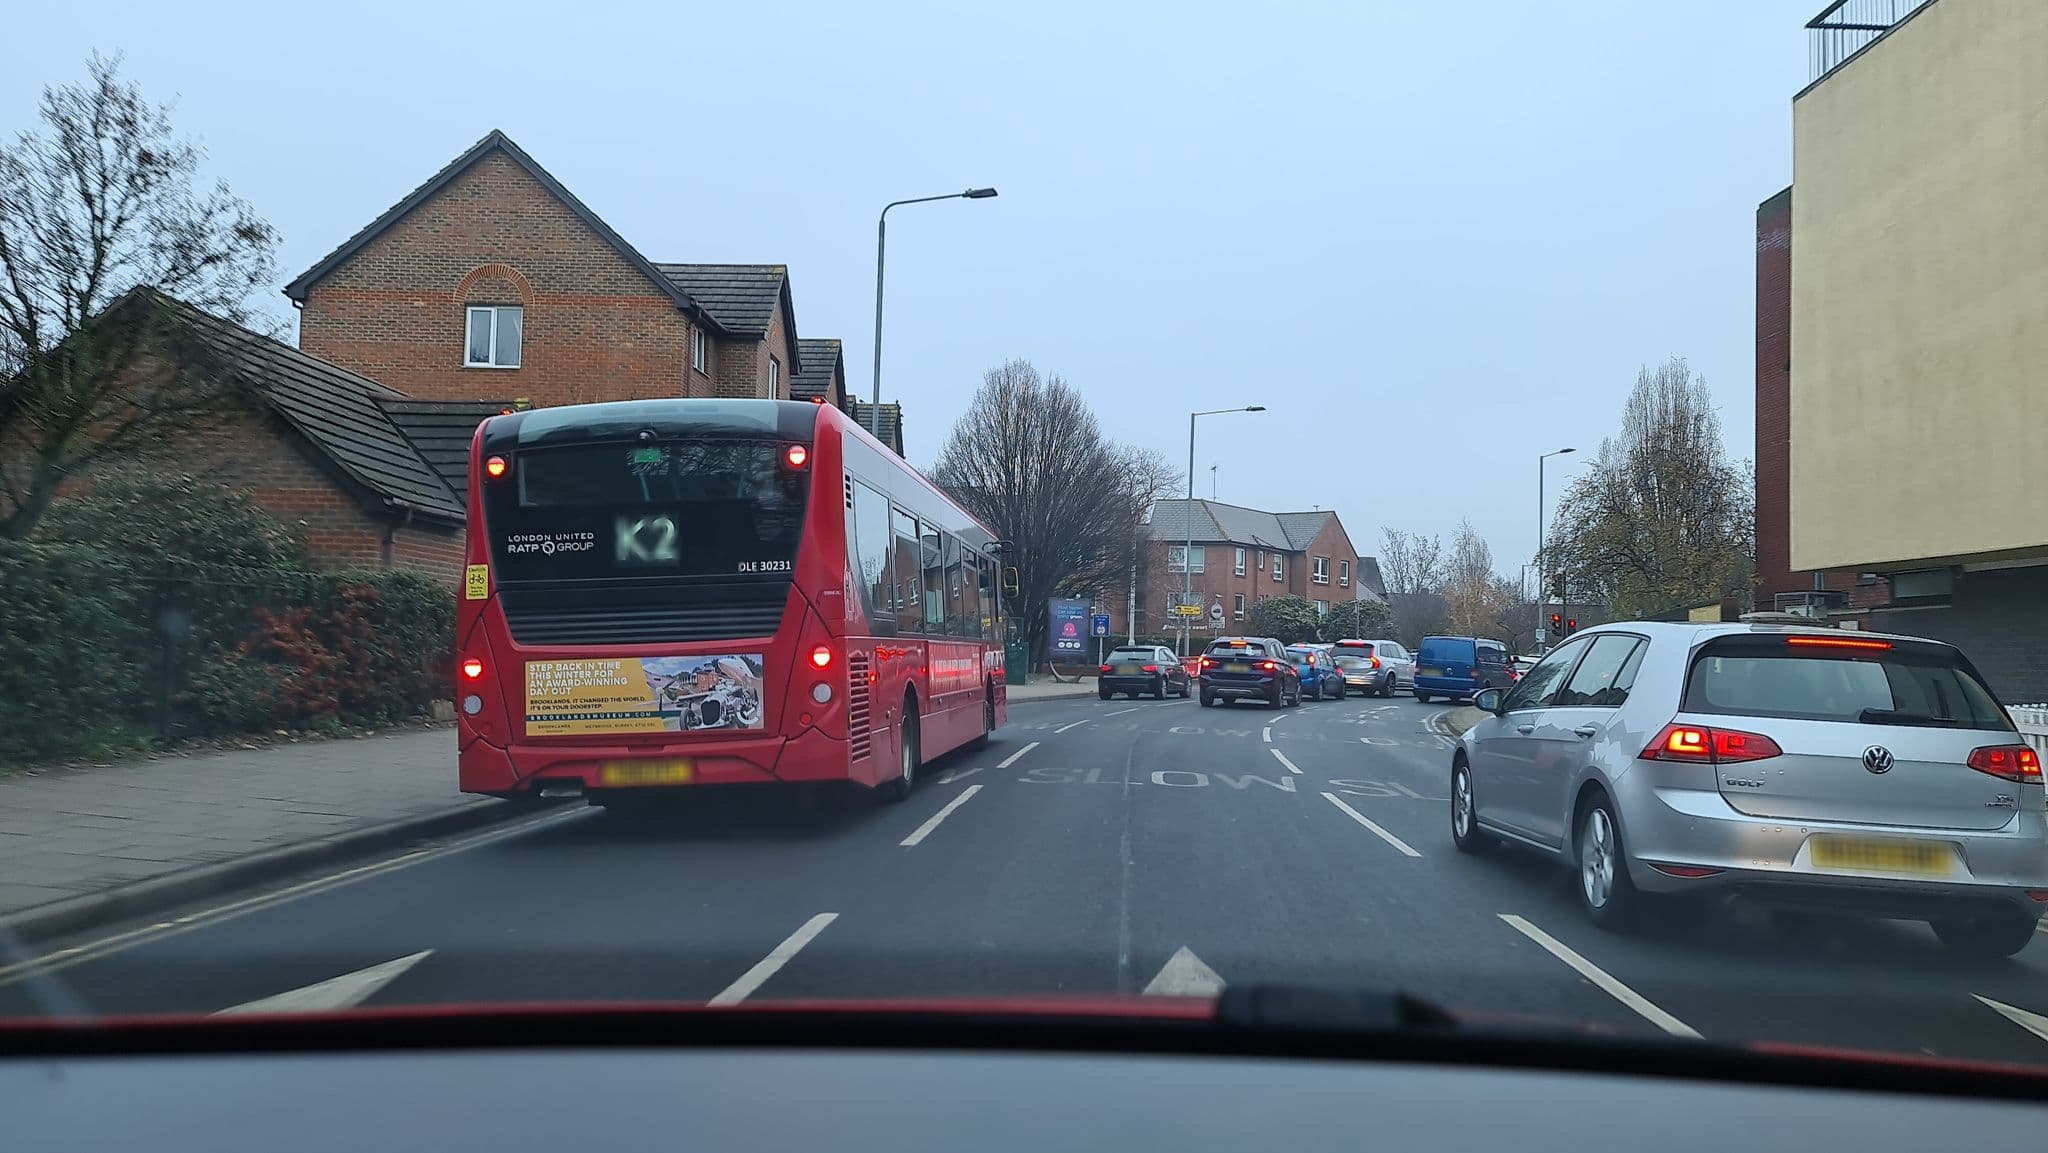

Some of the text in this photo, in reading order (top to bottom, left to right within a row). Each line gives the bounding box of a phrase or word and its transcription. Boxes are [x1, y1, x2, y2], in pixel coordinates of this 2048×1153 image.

[508, 532, 594, 543] LONDON UNITED
[616, 517, 676, 561] K2
[508, 541, 594, 553] RATP GROUP
[760, 560, 791, 571] 30231
[529, 661, 622, 672] STEP BACK IN TIME
[529, 669, 614, 680] THIS WINTER FOR
[529, 677, 628, 688] AN AWARD-WINNING
[529, 687, 572, 696] DAY OUT
[1018, 767, 1298, 792] SLOW
[1726, 778, 1765, 788] GOLF
